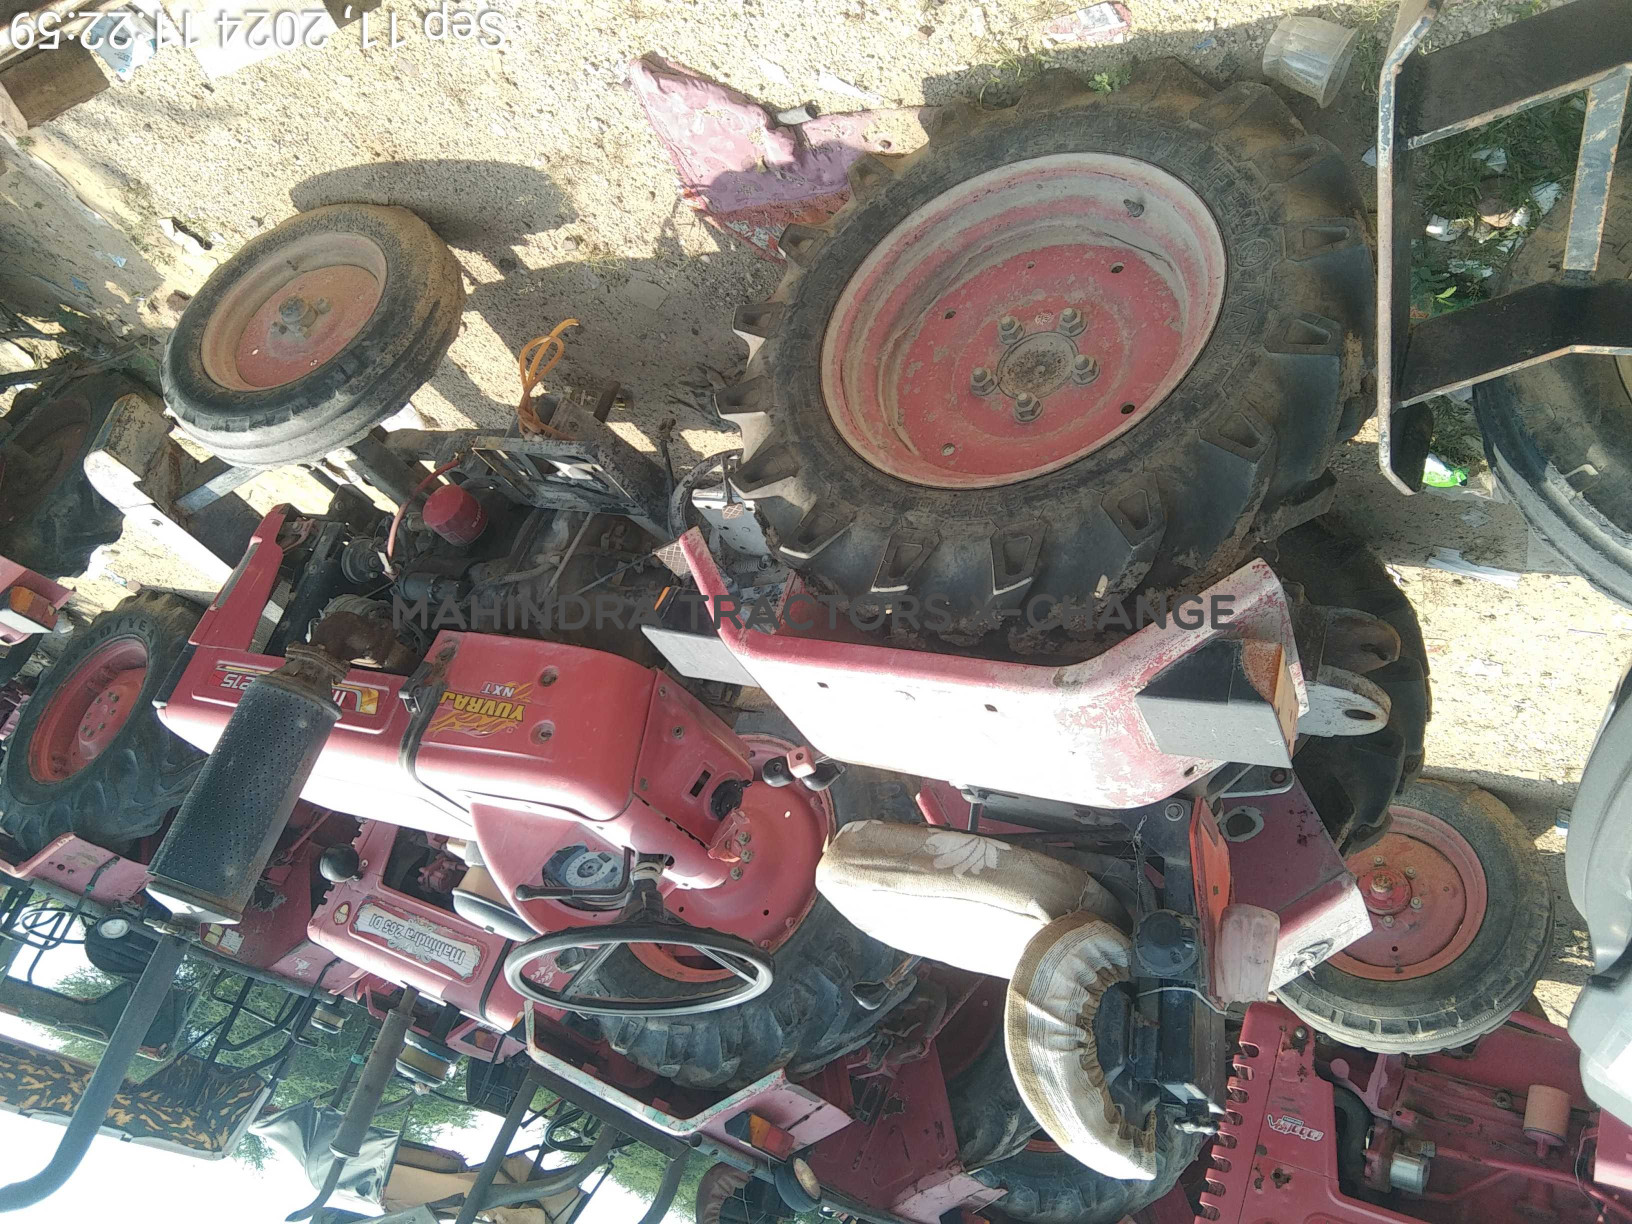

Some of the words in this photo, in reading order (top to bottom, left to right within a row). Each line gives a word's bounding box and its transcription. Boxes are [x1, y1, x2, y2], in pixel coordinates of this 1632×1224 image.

[480, 682, 515, 698] NXT
[440, 690, 526, 722] YUVRAJ
[368, 913, 384, 929] DI
[381, 919, 406, 938] 265
[405, 927, 466, 965] Mahindra
